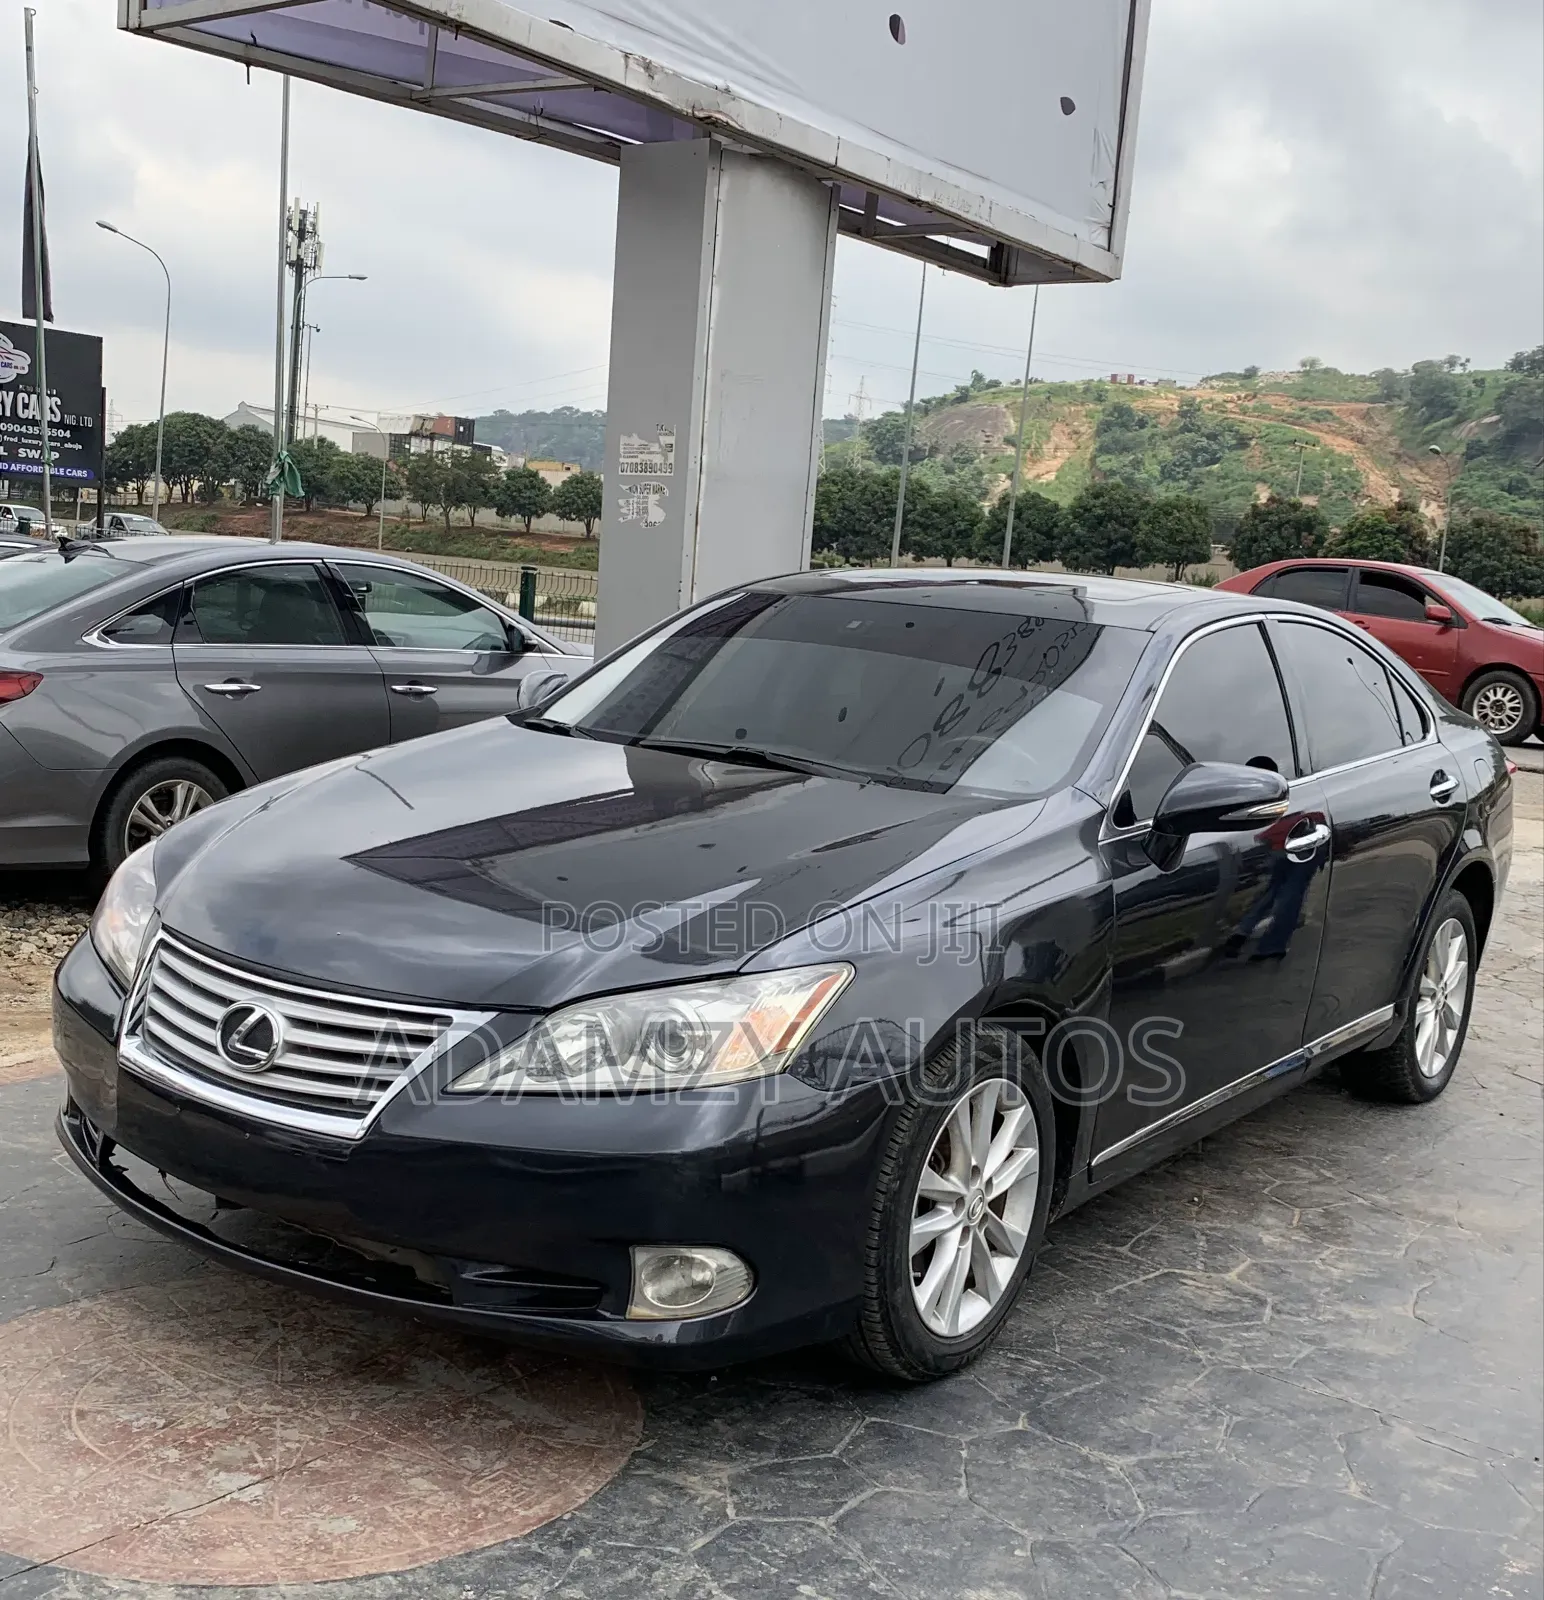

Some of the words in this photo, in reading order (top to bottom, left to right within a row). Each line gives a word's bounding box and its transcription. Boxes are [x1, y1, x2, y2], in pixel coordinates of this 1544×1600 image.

[80, 416, 93, 427] LTD
[10, 464, 65, 476] AFFORDBLE
[66, 469, 88, 478] CARS
